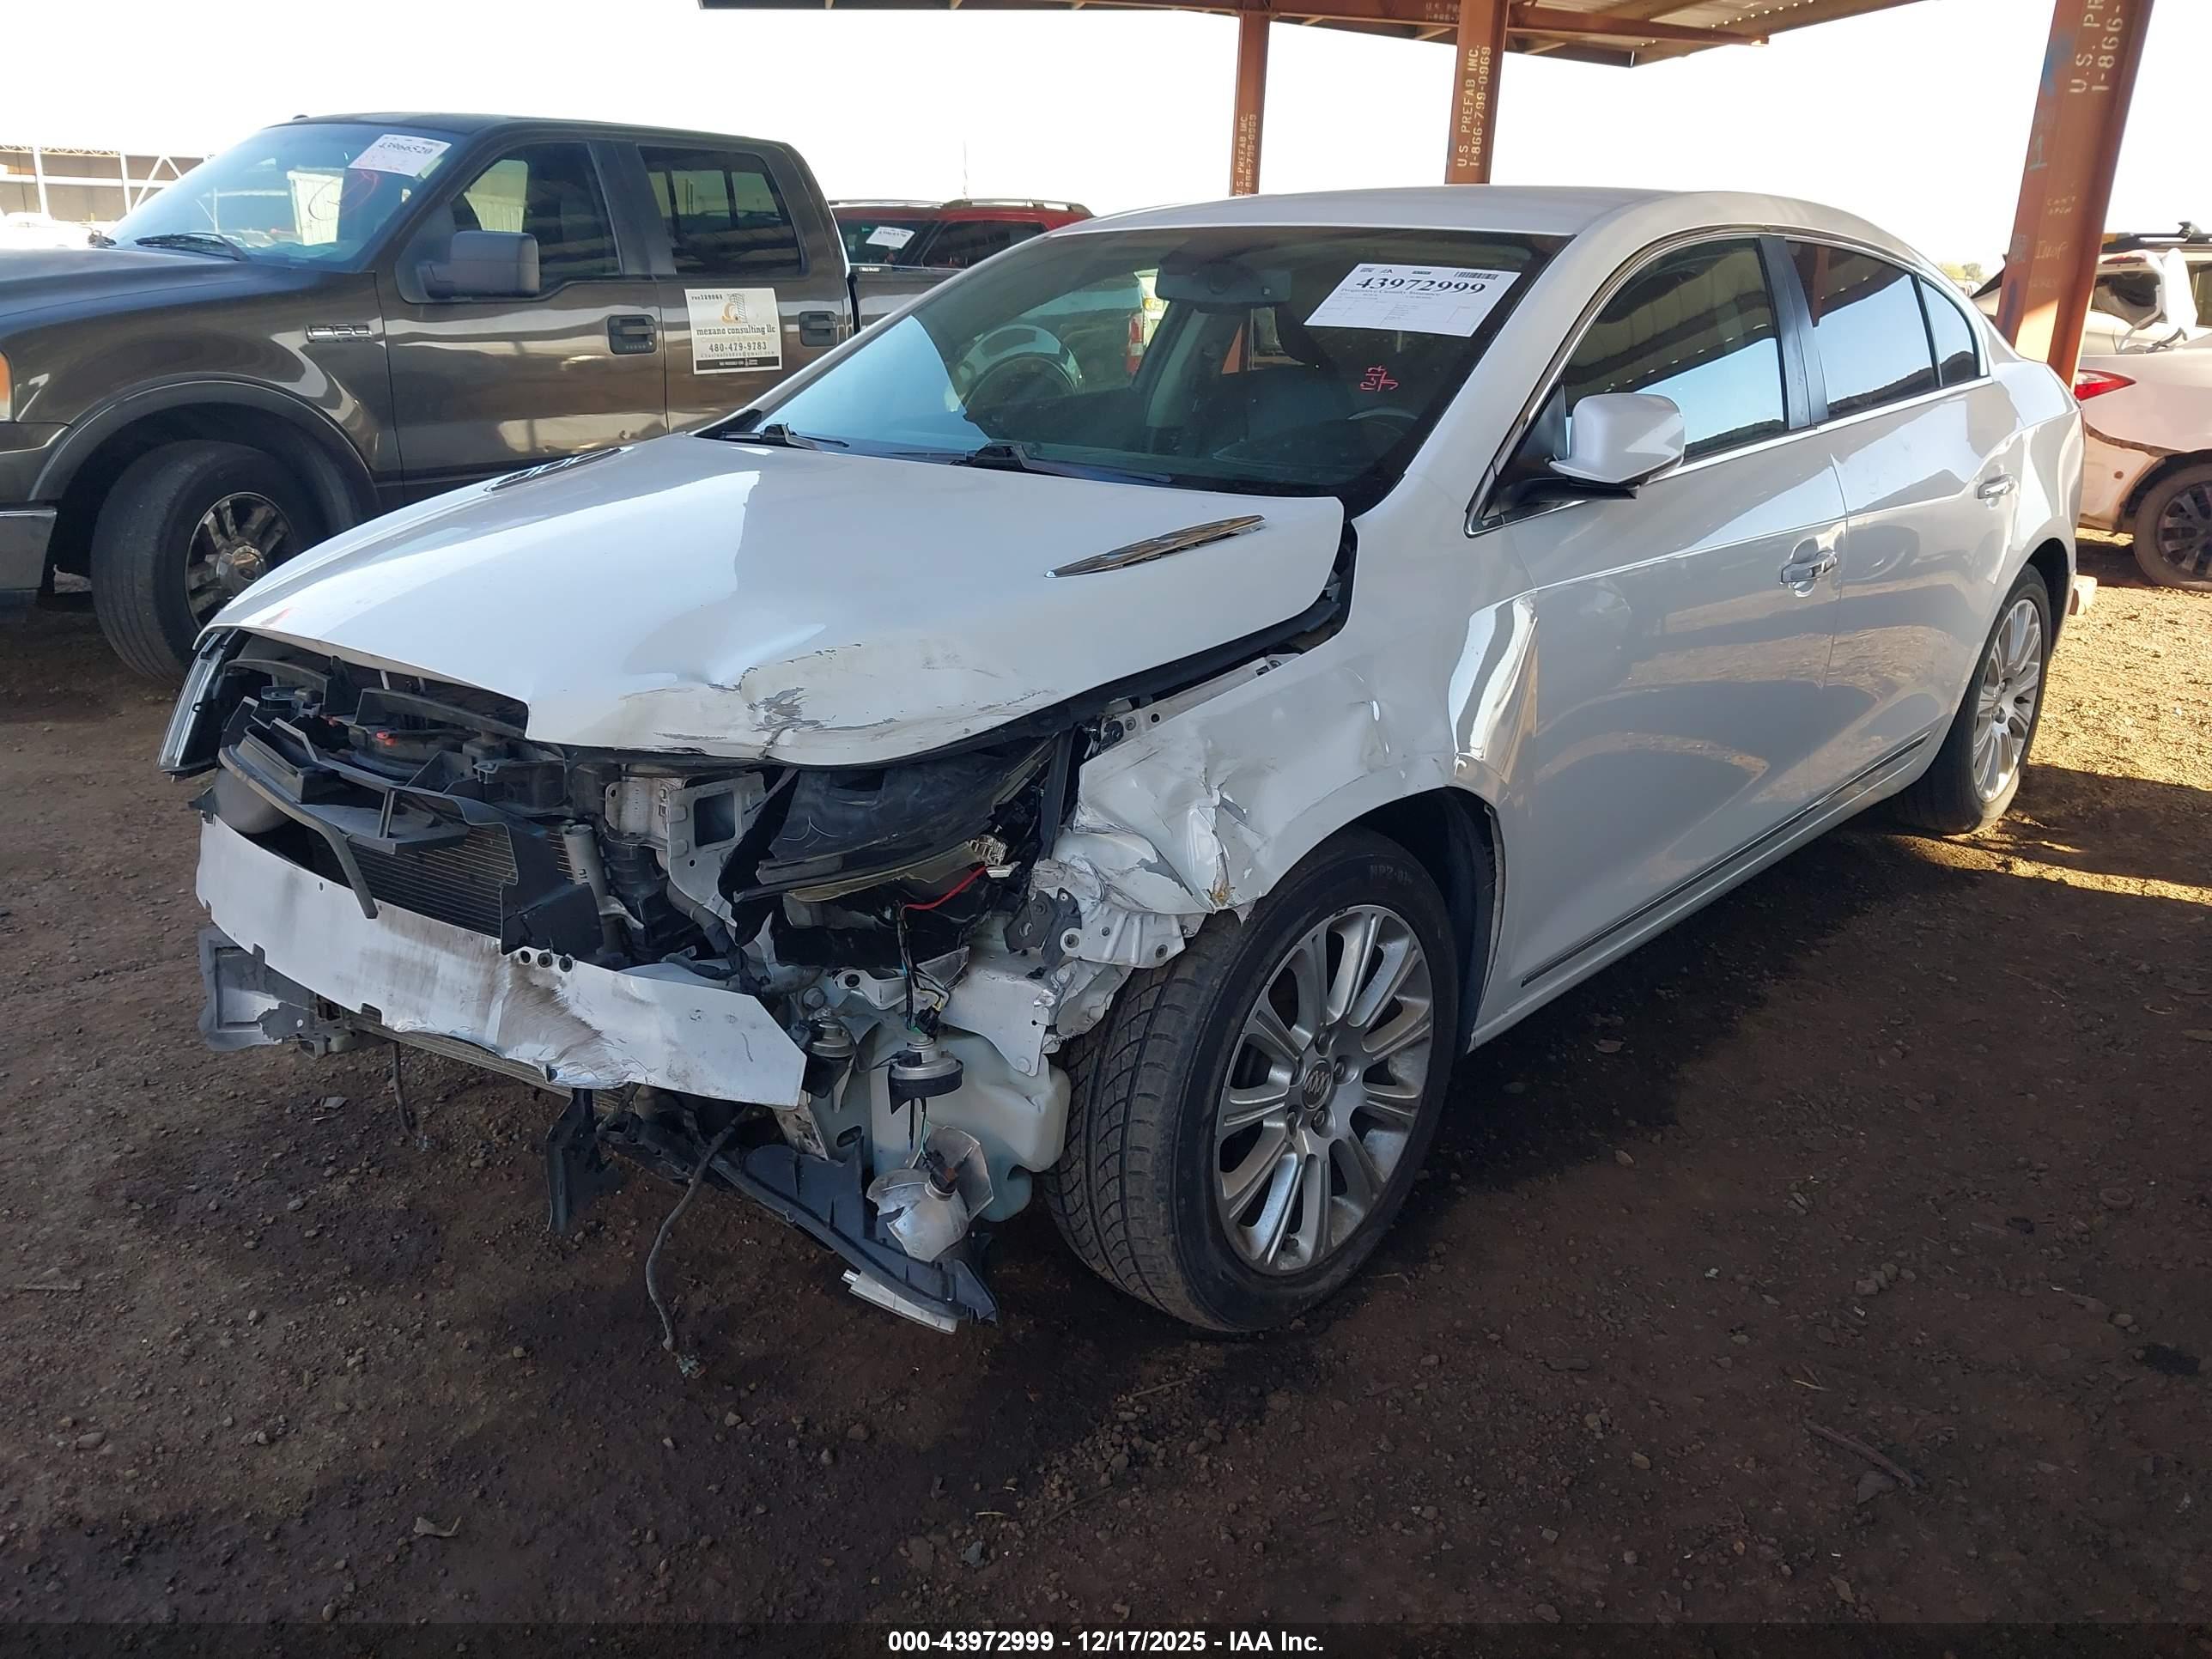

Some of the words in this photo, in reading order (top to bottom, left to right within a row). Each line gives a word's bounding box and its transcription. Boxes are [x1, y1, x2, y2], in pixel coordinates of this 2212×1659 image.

[1468, 45, 1480, 72] INC.
[2069, 45, 2095, 93] U.S.
[1461, 79, 1476, 133] PREFAB
[1469, 46, 1492, 167] 1-866-799-0969
[1356, 276, 1486, 295] 43972999
[727, 325, 765, 335] consulting
[767, 324, 776, 333] llc
[709, 341, 767, 353] 480-479-9783
